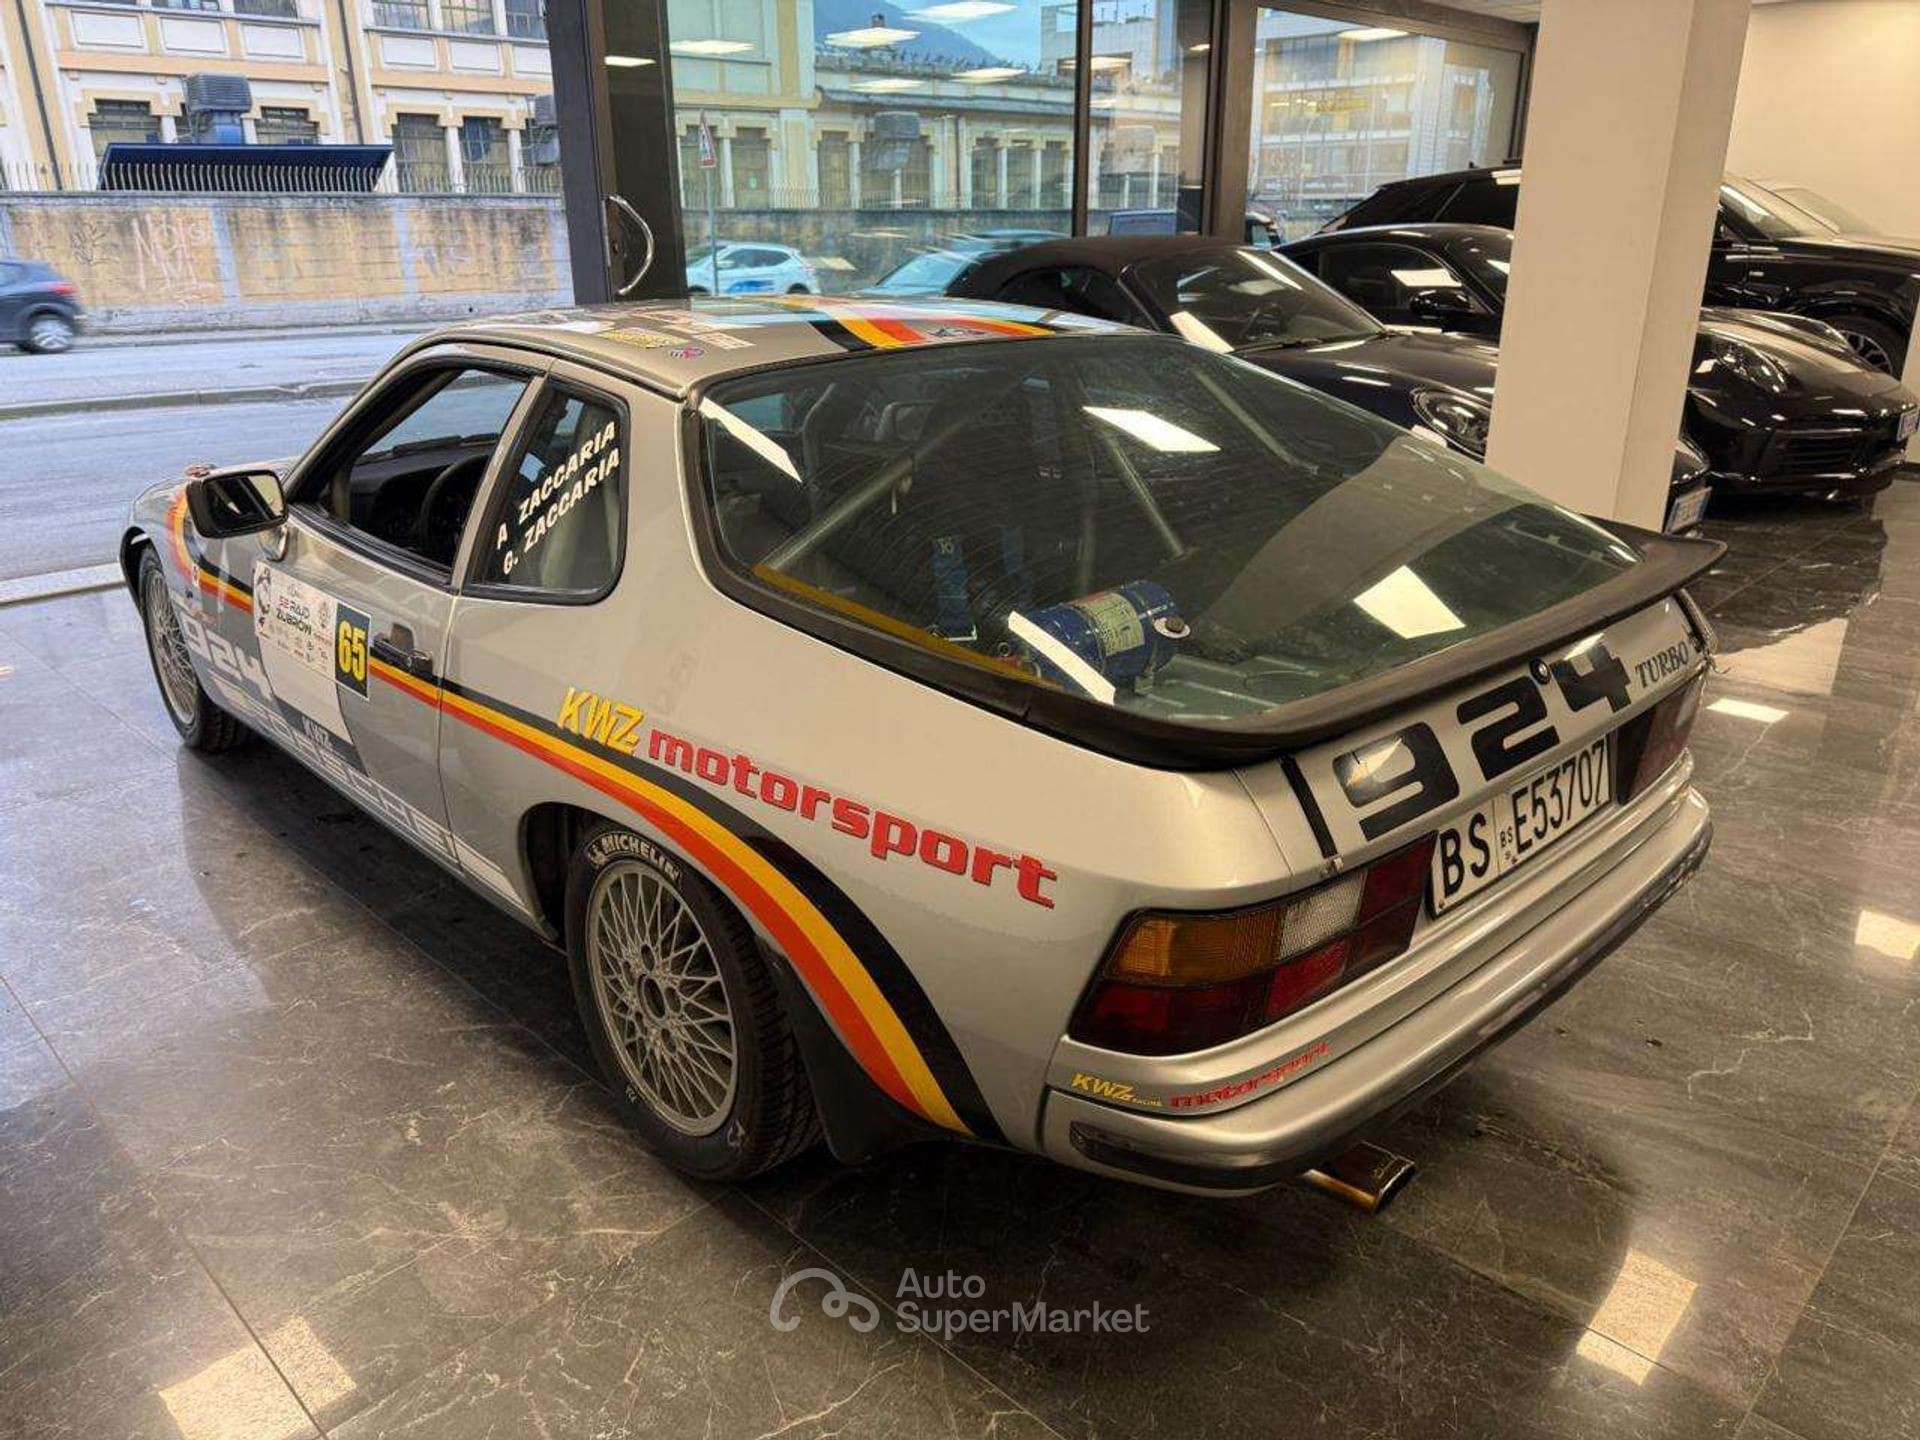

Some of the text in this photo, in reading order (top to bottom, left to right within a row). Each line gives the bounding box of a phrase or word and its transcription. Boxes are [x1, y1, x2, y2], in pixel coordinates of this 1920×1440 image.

[518, 421, 615, 525] ZACCARIA
[524, 448, 620, 552] ZACCARIA
[338, 620, 366, 681] 65
[1635, 641, 1689, 689] TURBO
[556, 686, 1058, 909] KWZ motorsport
[1439, 812, 1490, 899] BS
[1512, 737, 1606, 855] E53707
[602, 834, 682, 881] MICHELIN
[1071, 1072, 1134, 1102] KWZ
